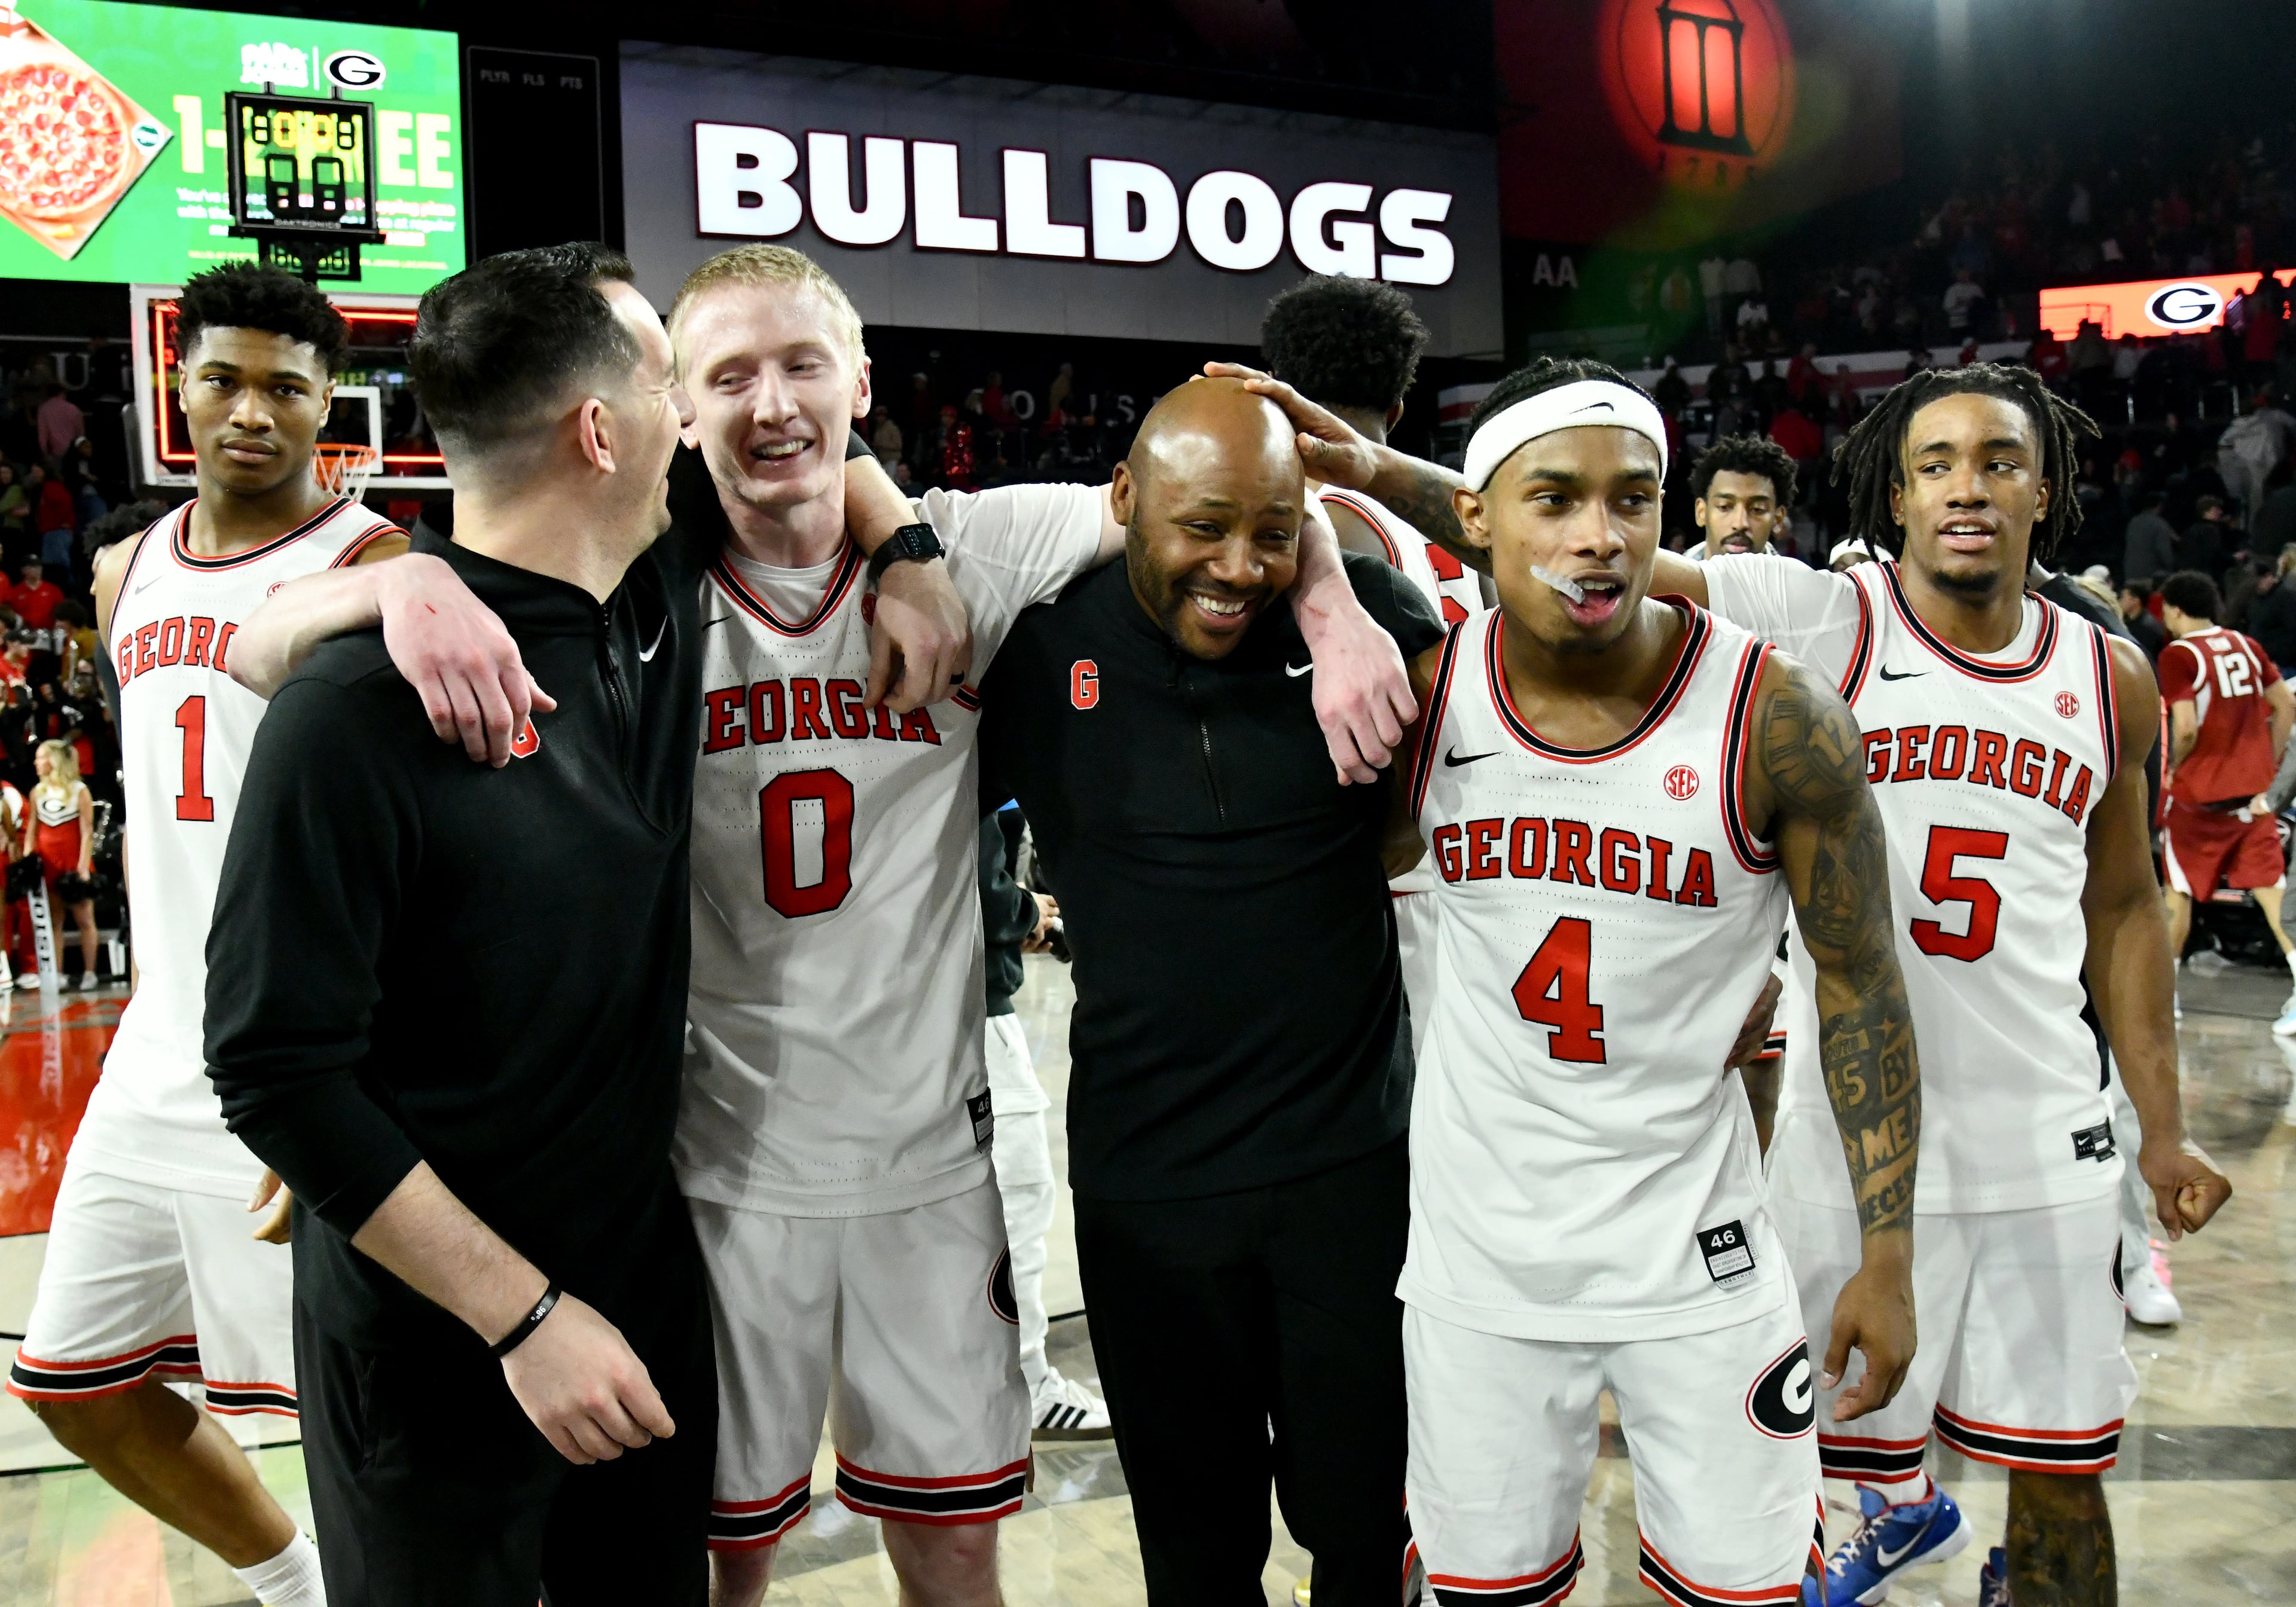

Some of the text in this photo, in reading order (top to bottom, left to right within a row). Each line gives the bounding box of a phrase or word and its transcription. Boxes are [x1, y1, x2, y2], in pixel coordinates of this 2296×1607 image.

[694, 121, 1455, 286] BULLDOGS
[1532, 253, 1579, 290] AA
[2152, 288, 2216, 324] G
[1070, 658, 1100, 710] G
[2056, 694, 2078, 716] SEC
[2212, 652, 2254, 699] 12
[175, 695, 215, 823] 1
[1667, 766, 1697, 798] SEC
[1861, 725, 2093, 827] GEORGIA
[759, 767, 855, 919] 0
[1432, 817, 1718, 908] GEORGIA
[1909, 824, 2010, 963] 5
[1510, 916, 1607, 1065] 4
[1711, 1230, 1736, 1248] 46
